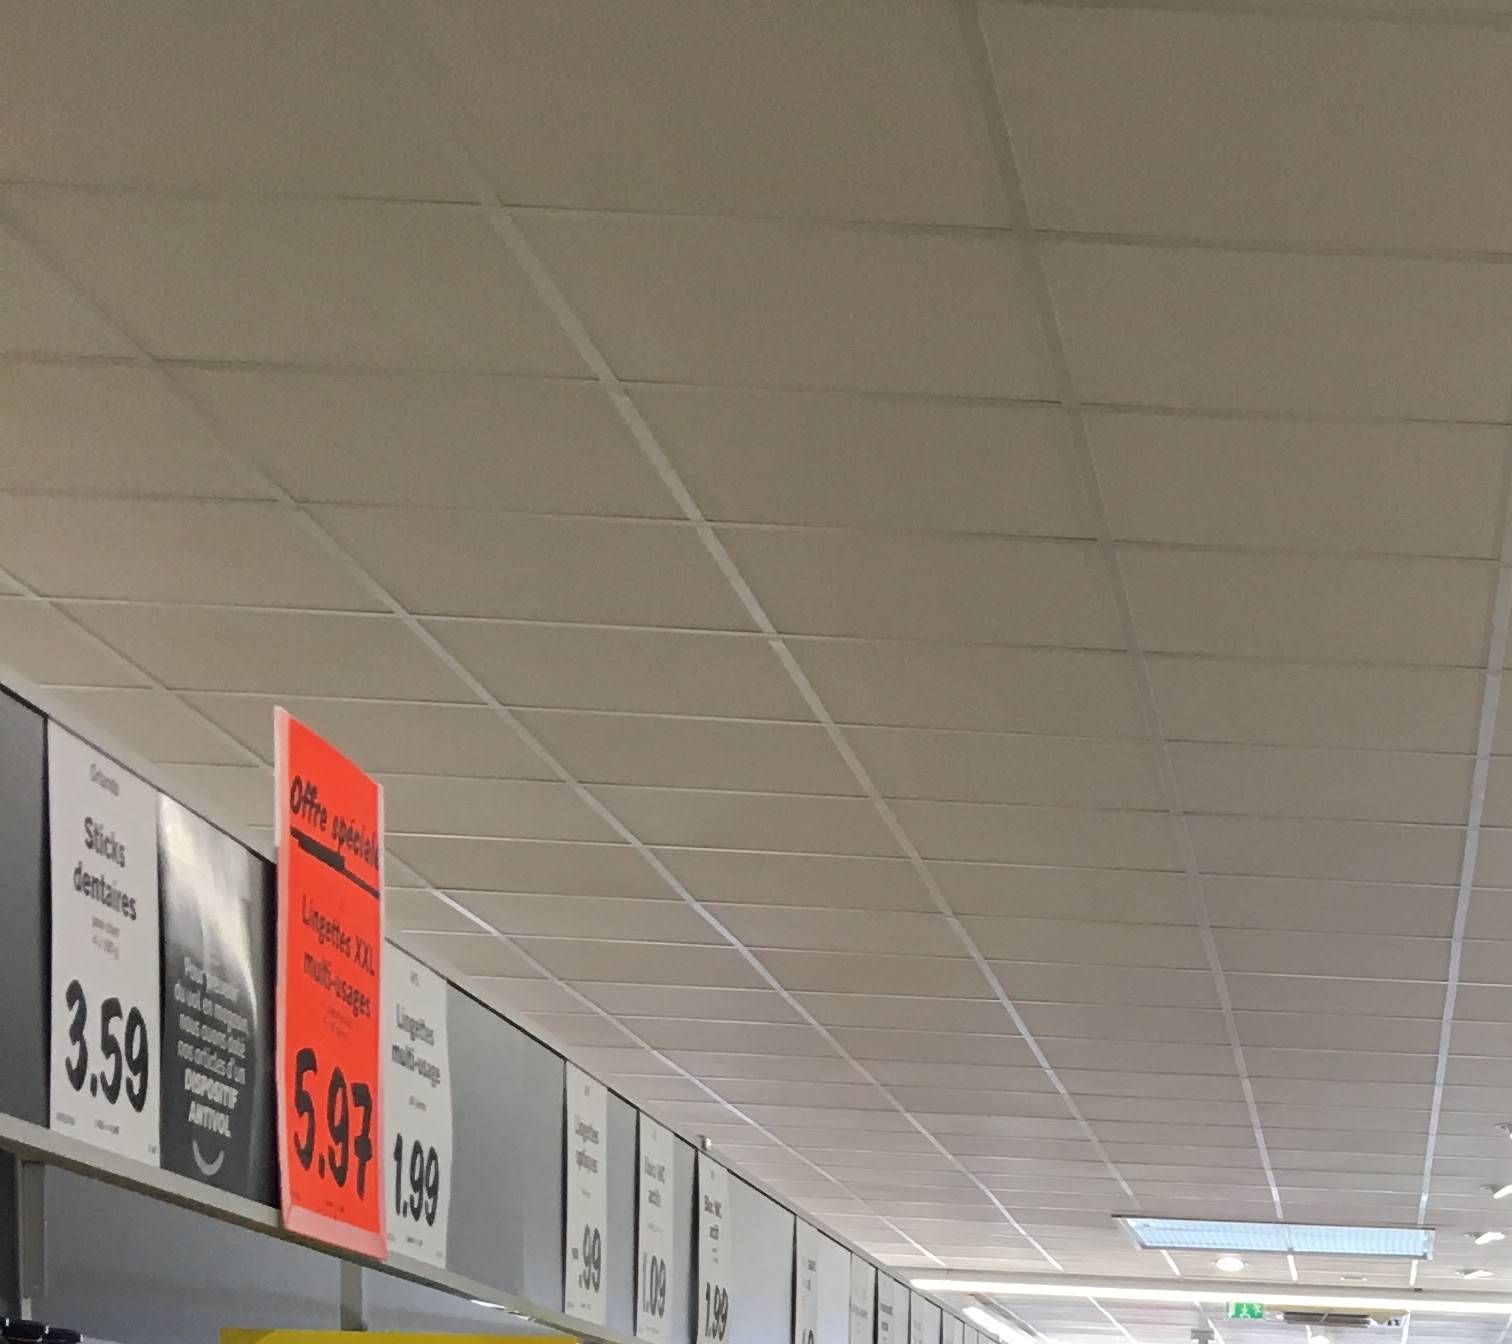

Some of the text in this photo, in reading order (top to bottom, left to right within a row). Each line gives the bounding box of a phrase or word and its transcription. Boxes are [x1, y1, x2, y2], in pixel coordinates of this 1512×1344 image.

[290, 774, 328, 832] Offre
[84, 816, 127, 868] Sticks
[72, 860, 138, 921] dentaires
[302, 894, 376, 977] Lingettes XXL
[303, 950, 371, 1019] multi-usages
[65, 979, 149, 1113] 3.59
[396, 1003, 435, 1046] Lingettes
[294, 1047, 373, 1200] 5.97
[394, 1132, 440, 1227] 1.99
